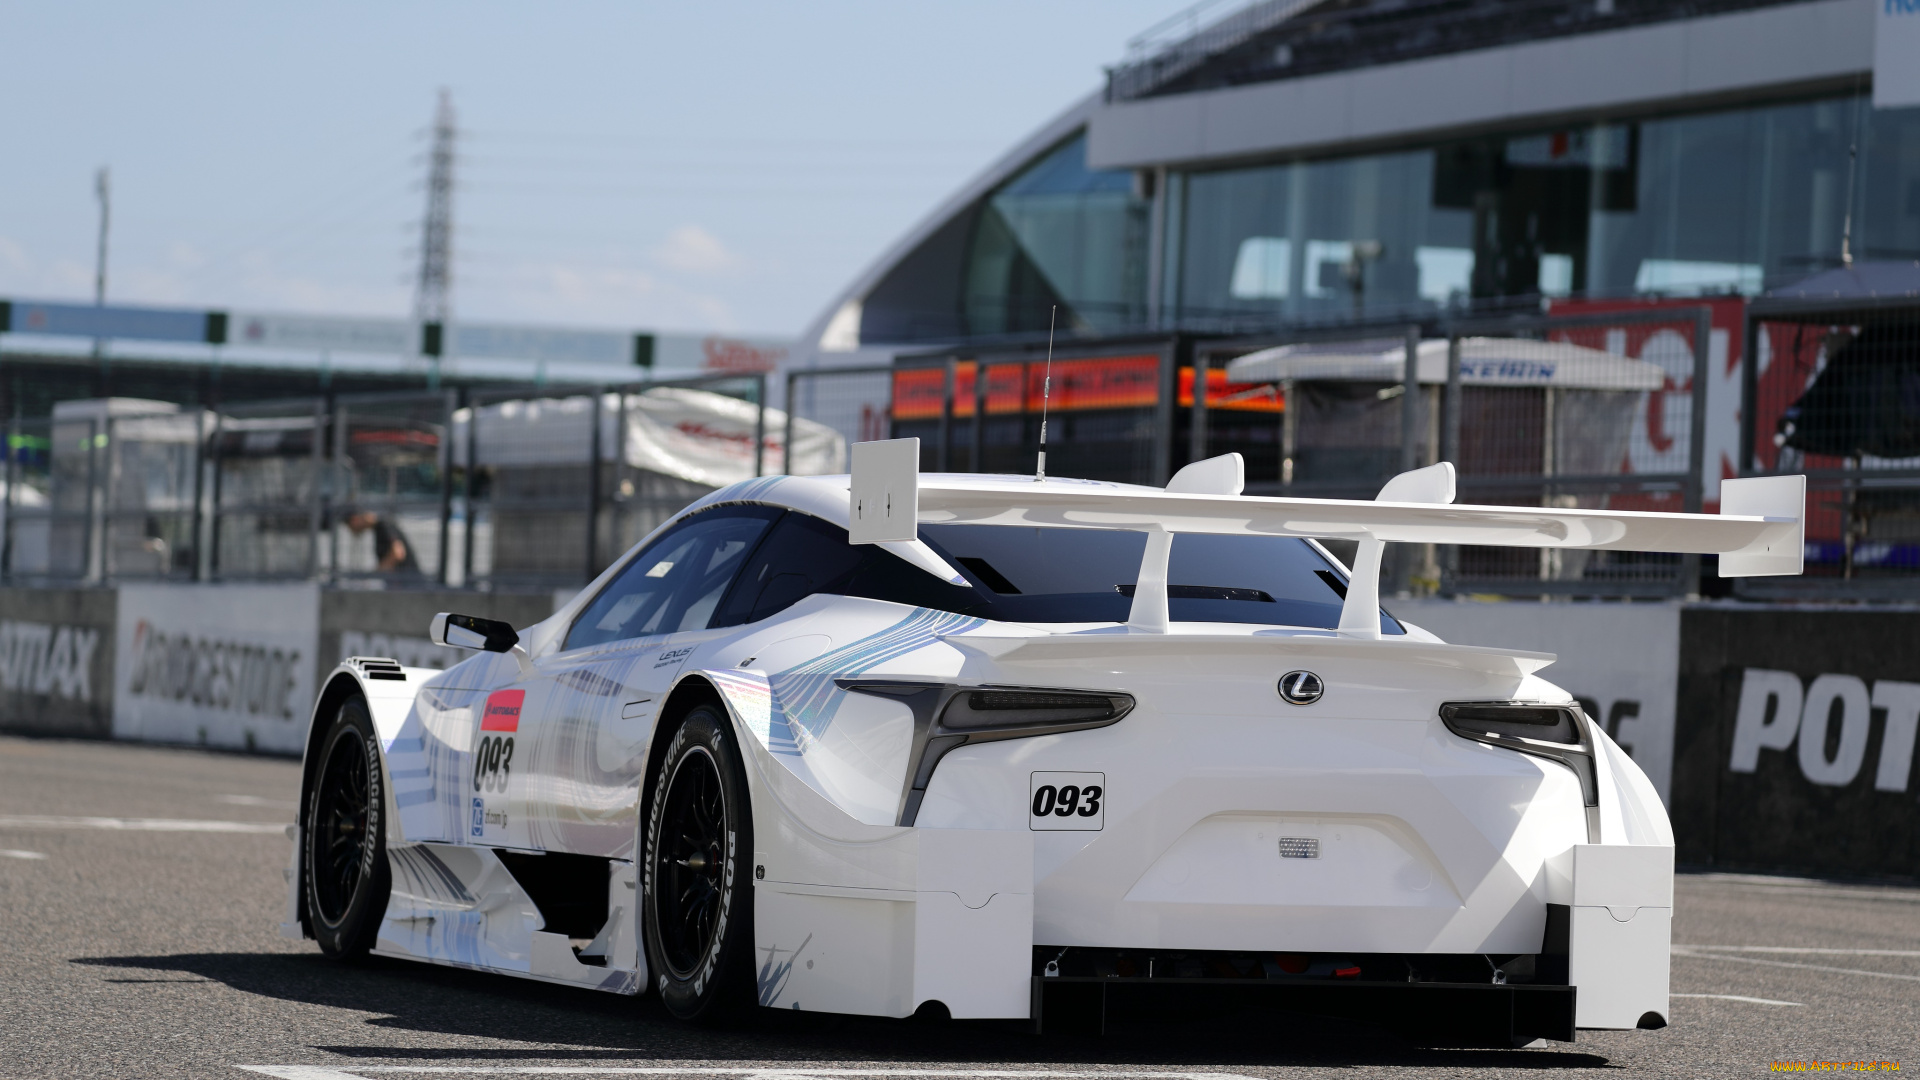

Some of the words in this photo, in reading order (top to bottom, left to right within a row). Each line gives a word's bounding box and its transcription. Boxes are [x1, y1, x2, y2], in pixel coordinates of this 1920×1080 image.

[659, 646, 693, 661] LEXUS
[1730, 667, 1920, 793] POT
[474, 735, 514, 794] 093
[1032, 784, 1103, 818] 093
[694, 830, 736, 997] POTENZA
